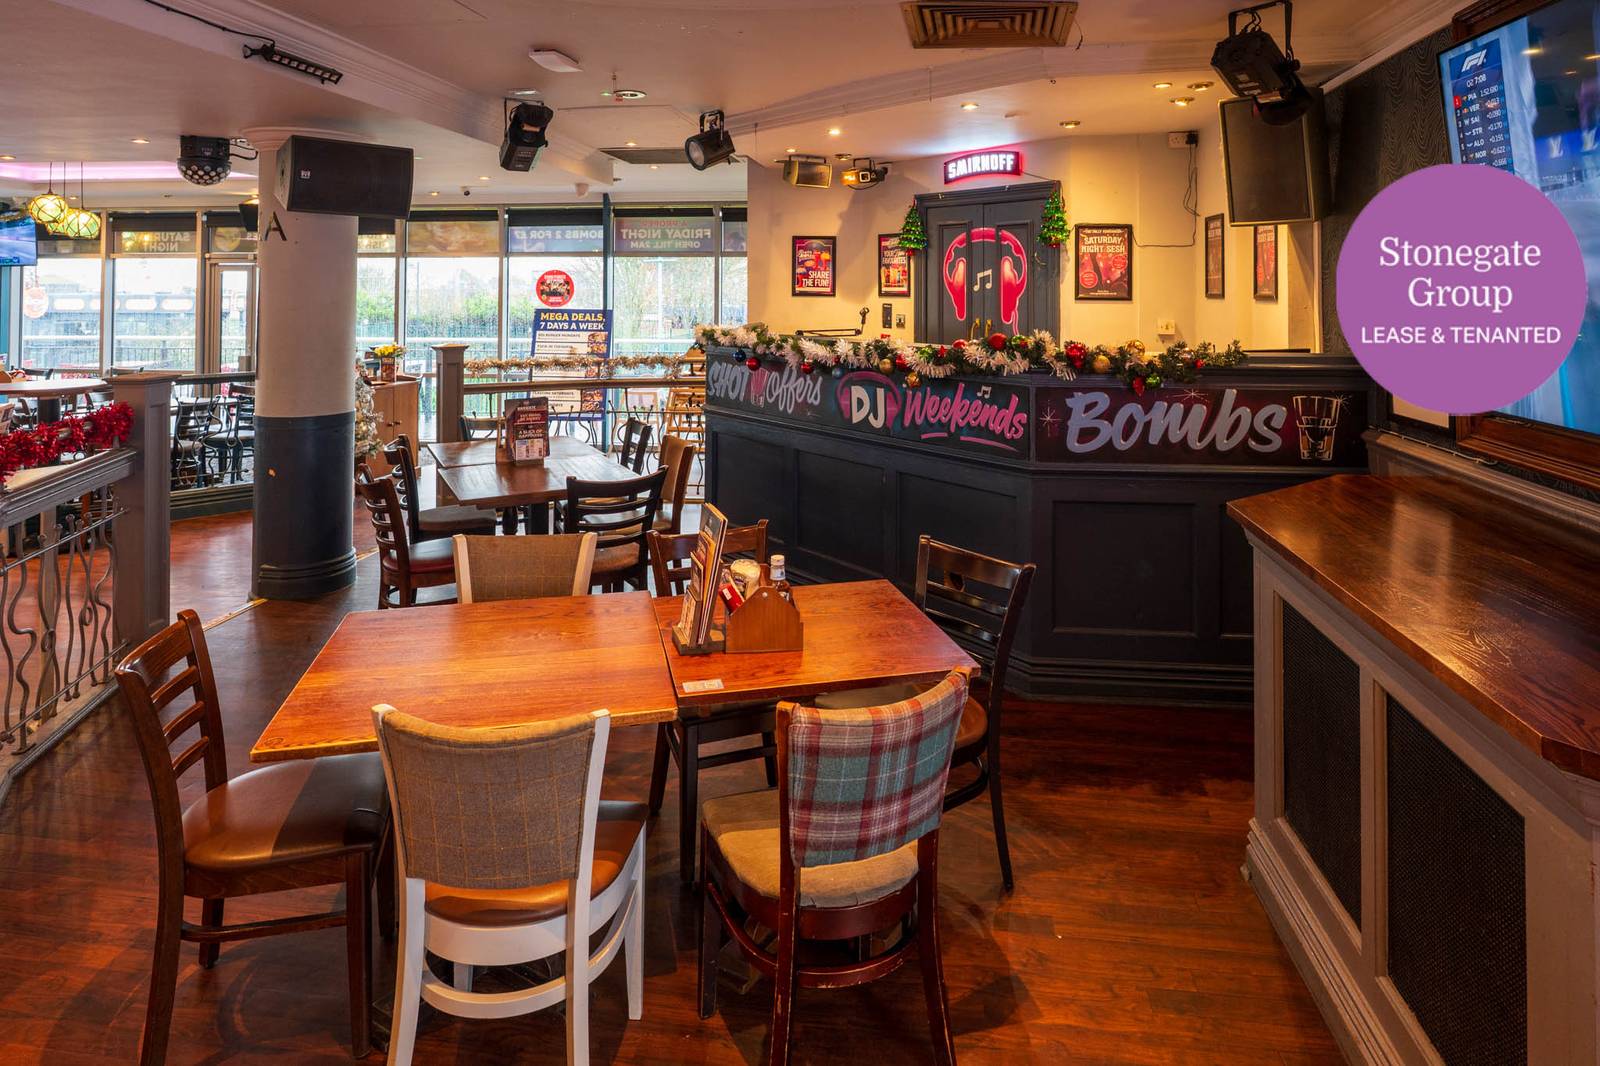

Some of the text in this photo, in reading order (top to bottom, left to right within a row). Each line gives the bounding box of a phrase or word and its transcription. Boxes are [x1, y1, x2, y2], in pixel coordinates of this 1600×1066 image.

[1467, 92, 1477, 102] PIA
[1469, 103, 1481, 113] VER
[1471, 127, 1483, 136] STR
[1473, 138, 1485, 148] ALO
[1474, 150, 1487, 159] NOR
[947, 153, 1015, 179] SMIRNOFF
[264, 211, 288, 242] A
[1083, 236, 1123, 245] SATURDAY
[1081, 243, 1125, 253] NIGHT SESH
[808, 270, 830, 279] SHARE
[802, 278, 814, 287] THE
[540, 312, 569, 321] MEGA
[540, 321, 546, 330] 7
[547, 322, 569, 330] DAYS
[578, 322, 605, 330] WEEK
[708, 361, 823, 414] SHOT Offers
[851, 382, 1027, 439] DJ Weekends
[1065, 388, 1288, 453] Bombs
